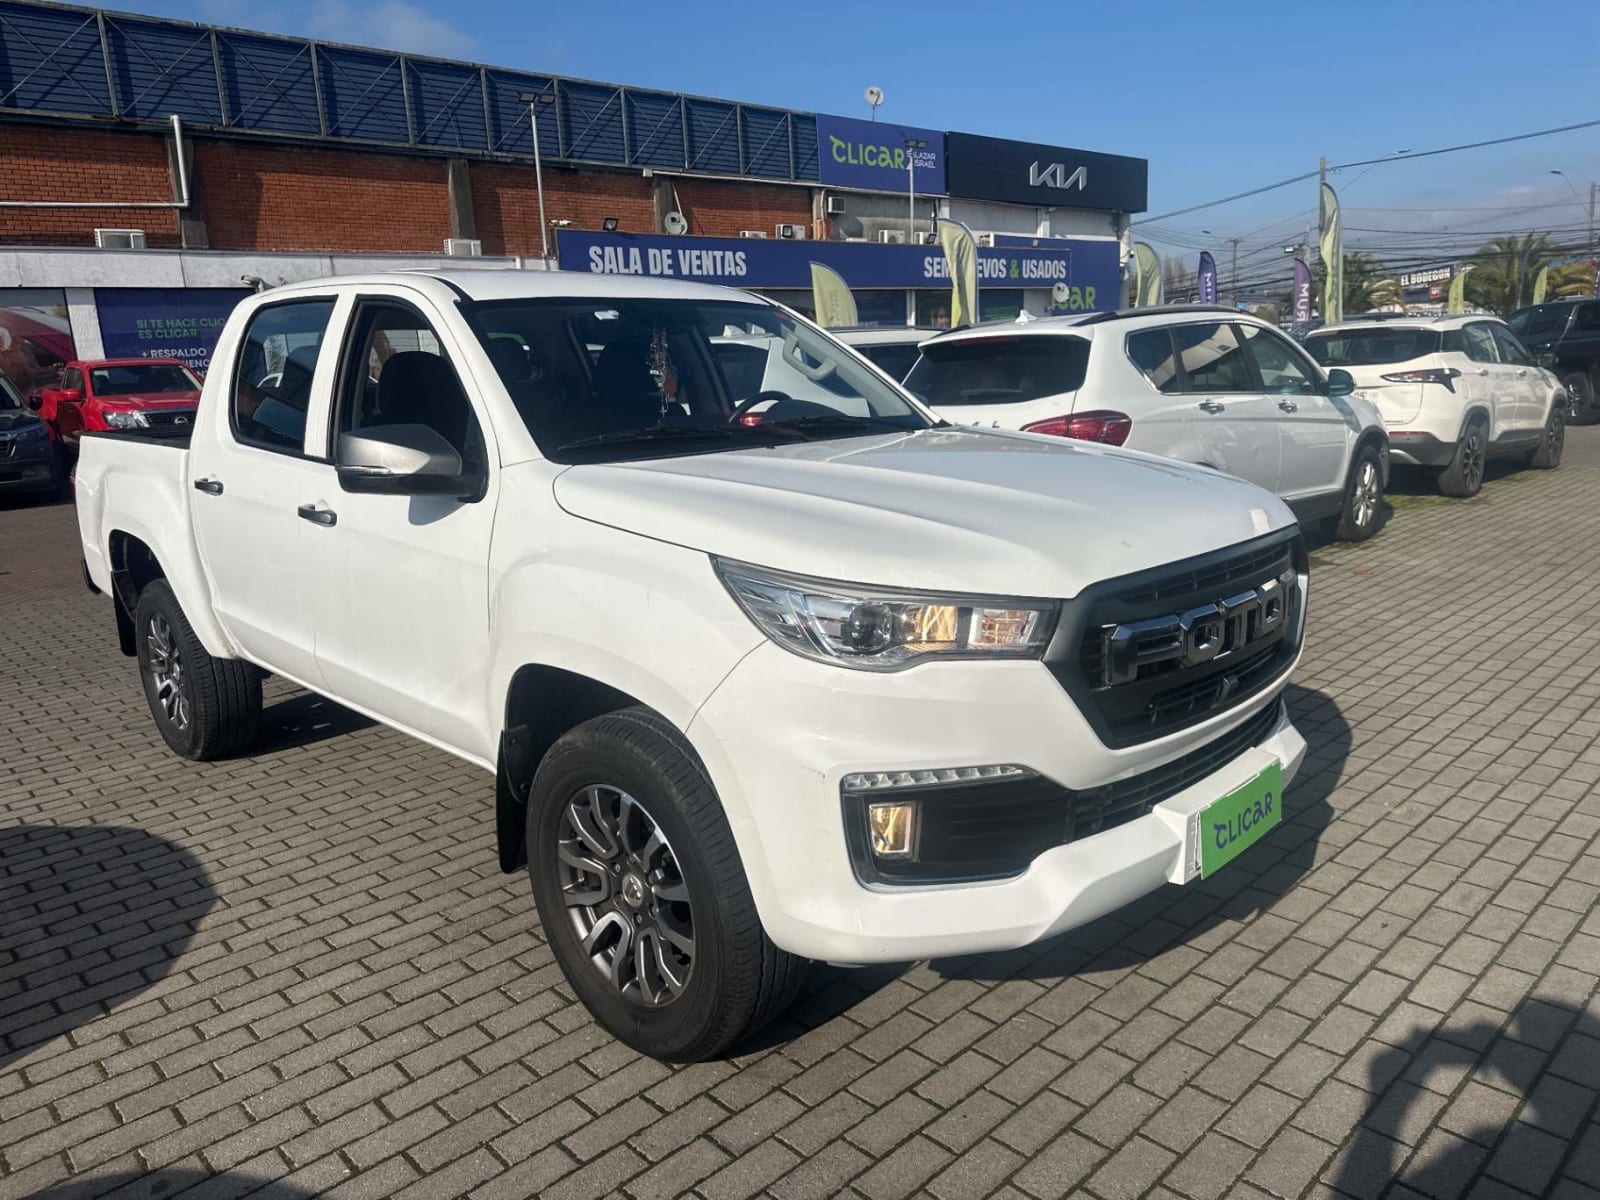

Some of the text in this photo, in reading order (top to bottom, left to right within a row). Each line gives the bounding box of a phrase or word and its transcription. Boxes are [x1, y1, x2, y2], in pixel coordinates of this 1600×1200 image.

[1029, 161, 1087, 191] KIA
[588, 245, 747, 276] SALA DE VENTAS
[1022, 260, 1066, 279] USADOS
[136, 318, 225, 329] SI TE HACE CLIC
[138, 329, 197, 339] ES CLICAR
[151, 347, 207, 358] RESPALDO
